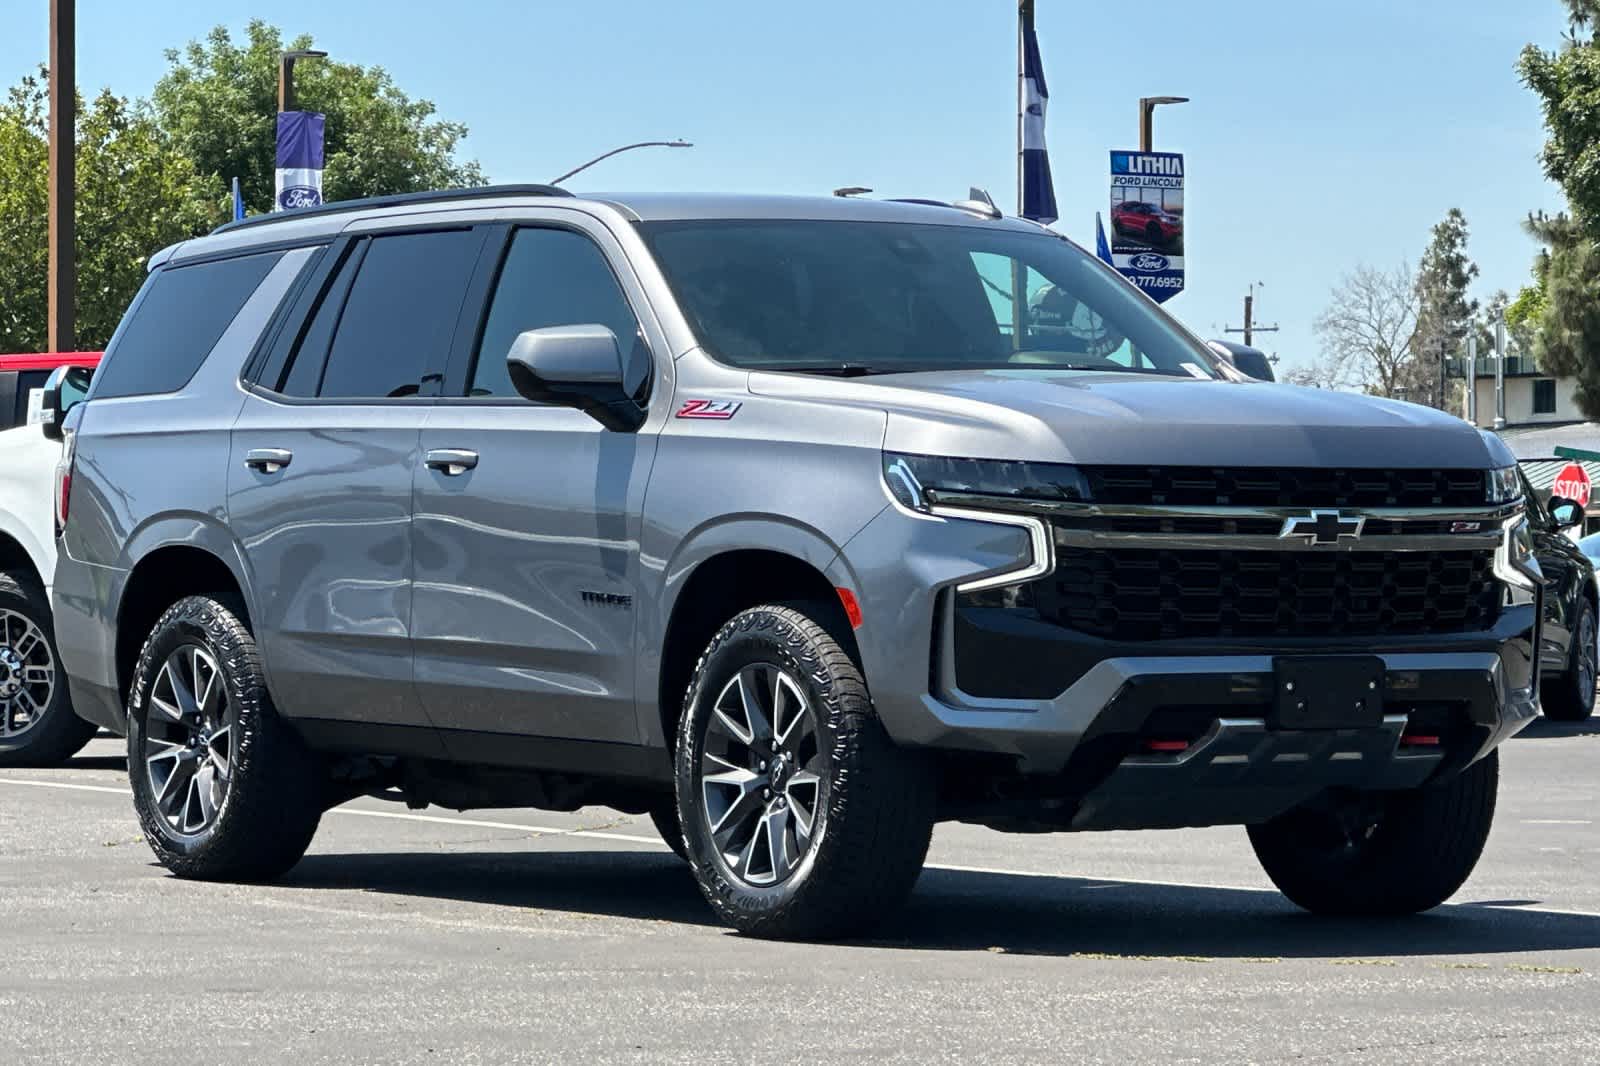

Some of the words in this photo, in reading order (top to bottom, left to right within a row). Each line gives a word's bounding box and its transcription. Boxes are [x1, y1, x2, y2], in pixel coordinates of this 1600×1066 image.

[1128, 155, 1182, 175] LITHIA
[1114, 176, 1141, 185] FORD
[1142, 177, 1182, 187] LINCOLN
[286, 189, 317, 208] Ford
[1136, 255, 1163, 269] Ford
[676, 400, 743, 420] Z71
[1555, 479, 1589, 499] STOP
